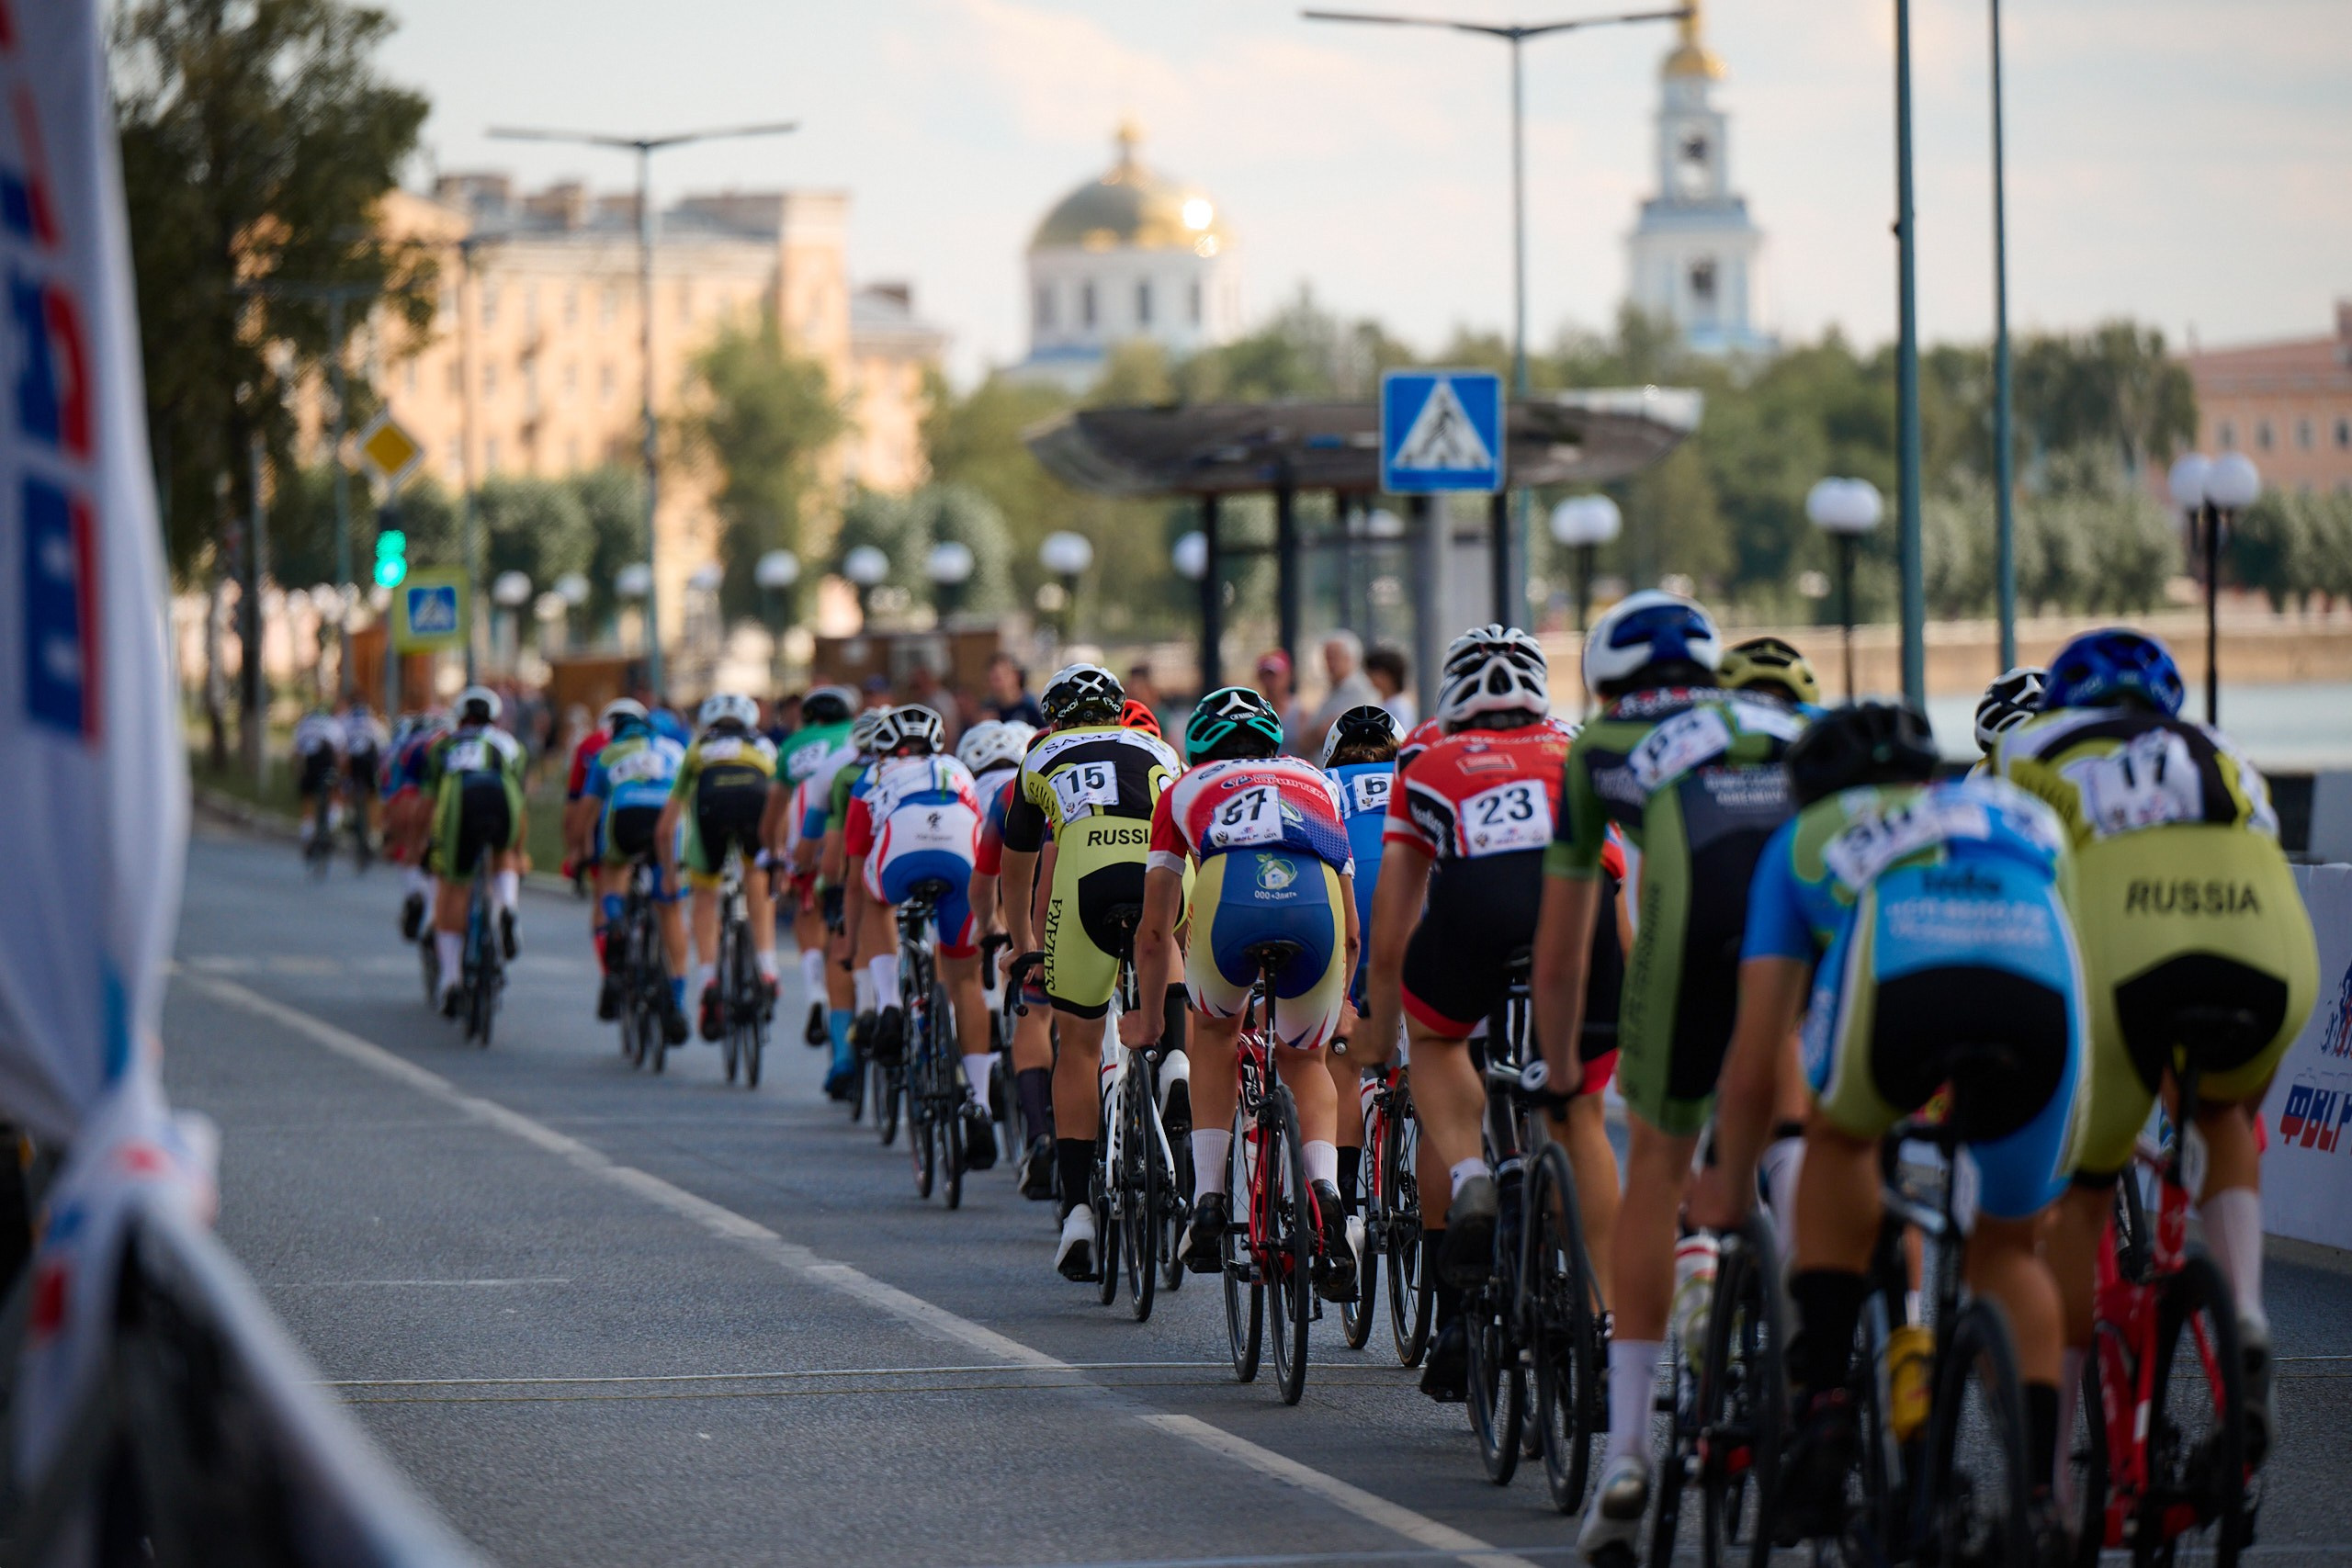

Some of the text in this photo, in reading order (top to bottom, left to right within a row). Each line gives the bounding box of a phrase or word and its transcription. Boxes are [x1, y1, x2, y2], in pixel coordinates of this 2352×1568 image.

[1067, 766, 1105, 795] 15
[1221, 787, 1268, 826] 57
[1476, 787, 1533, 825] 23
[1087, 829, 1151, 846] RUSSI
[2125, 880, 2260, 915] RUSSIA
[1045, 898, 1063, 991] SAMARA
